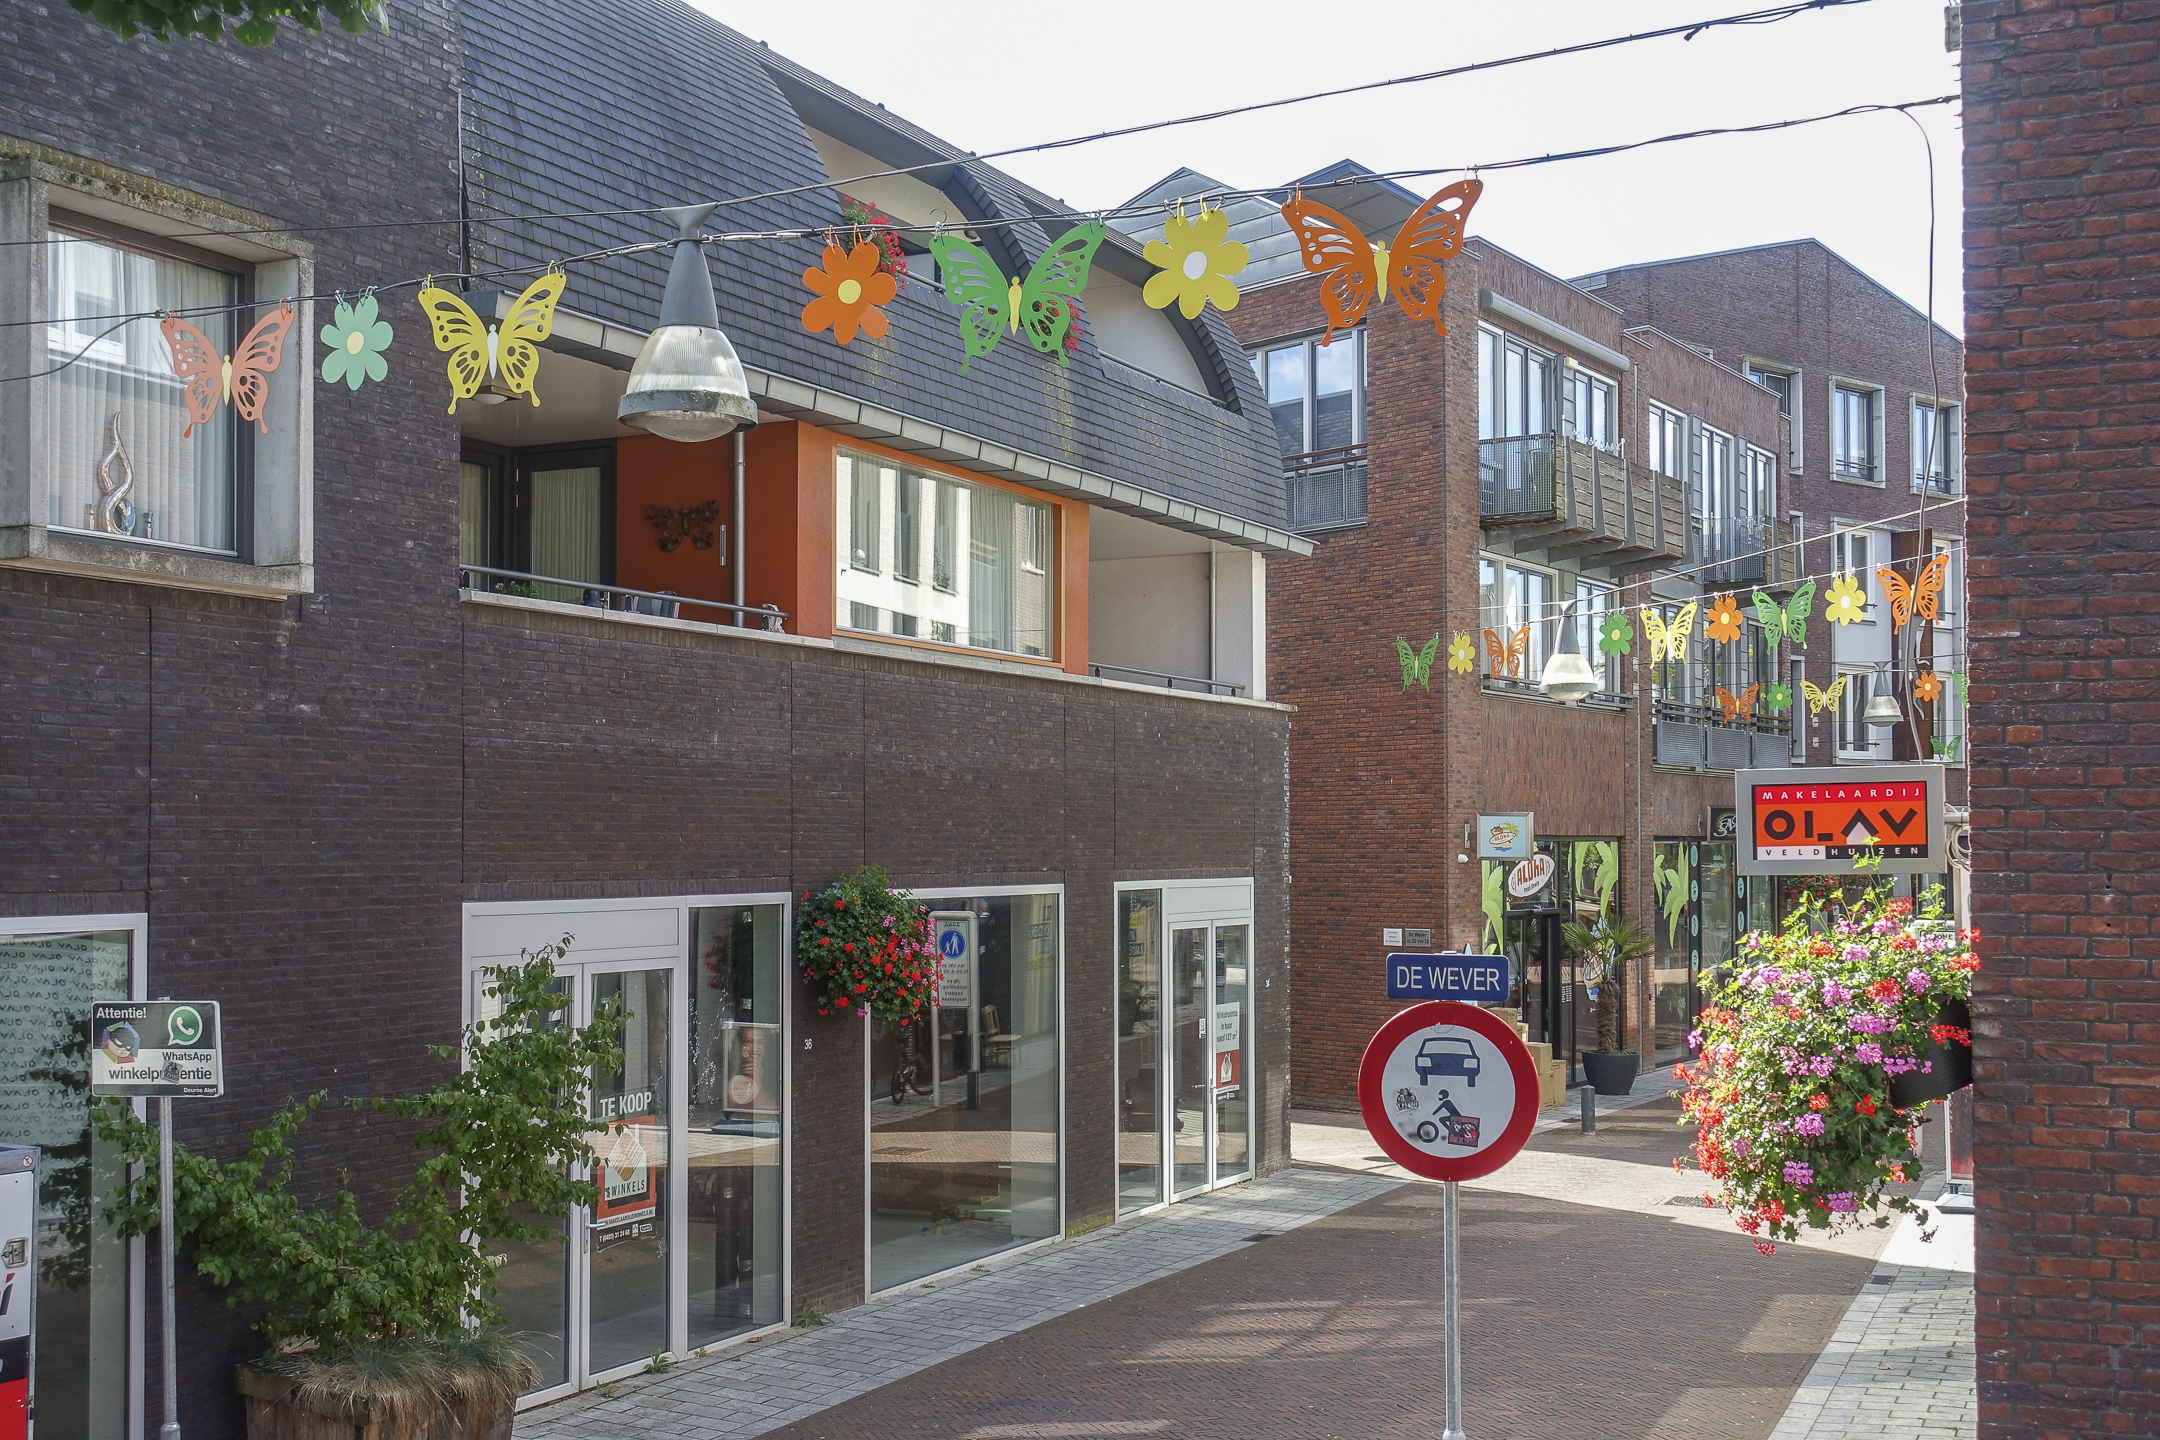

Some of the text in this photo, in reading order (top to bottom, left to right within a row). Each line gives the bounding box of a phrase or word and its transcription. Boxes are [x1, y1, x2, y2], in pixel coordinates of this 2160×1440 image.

[1762, 787, 1920, 800] MAKELAARDIJ
[1763, 807, 1918, 843] OLAV
[1765, 846, 1919, 856] VELDHUIZEN
[1396, 965, 1501, 992] DE WEVER
[96, 1006, 147, 1019] Attentie!
[804, 1038, 813, 1050] 36
[162, 1051, 212, 1063] WhatsApp
[600, 1091, 652, 1118] TE KOOP
